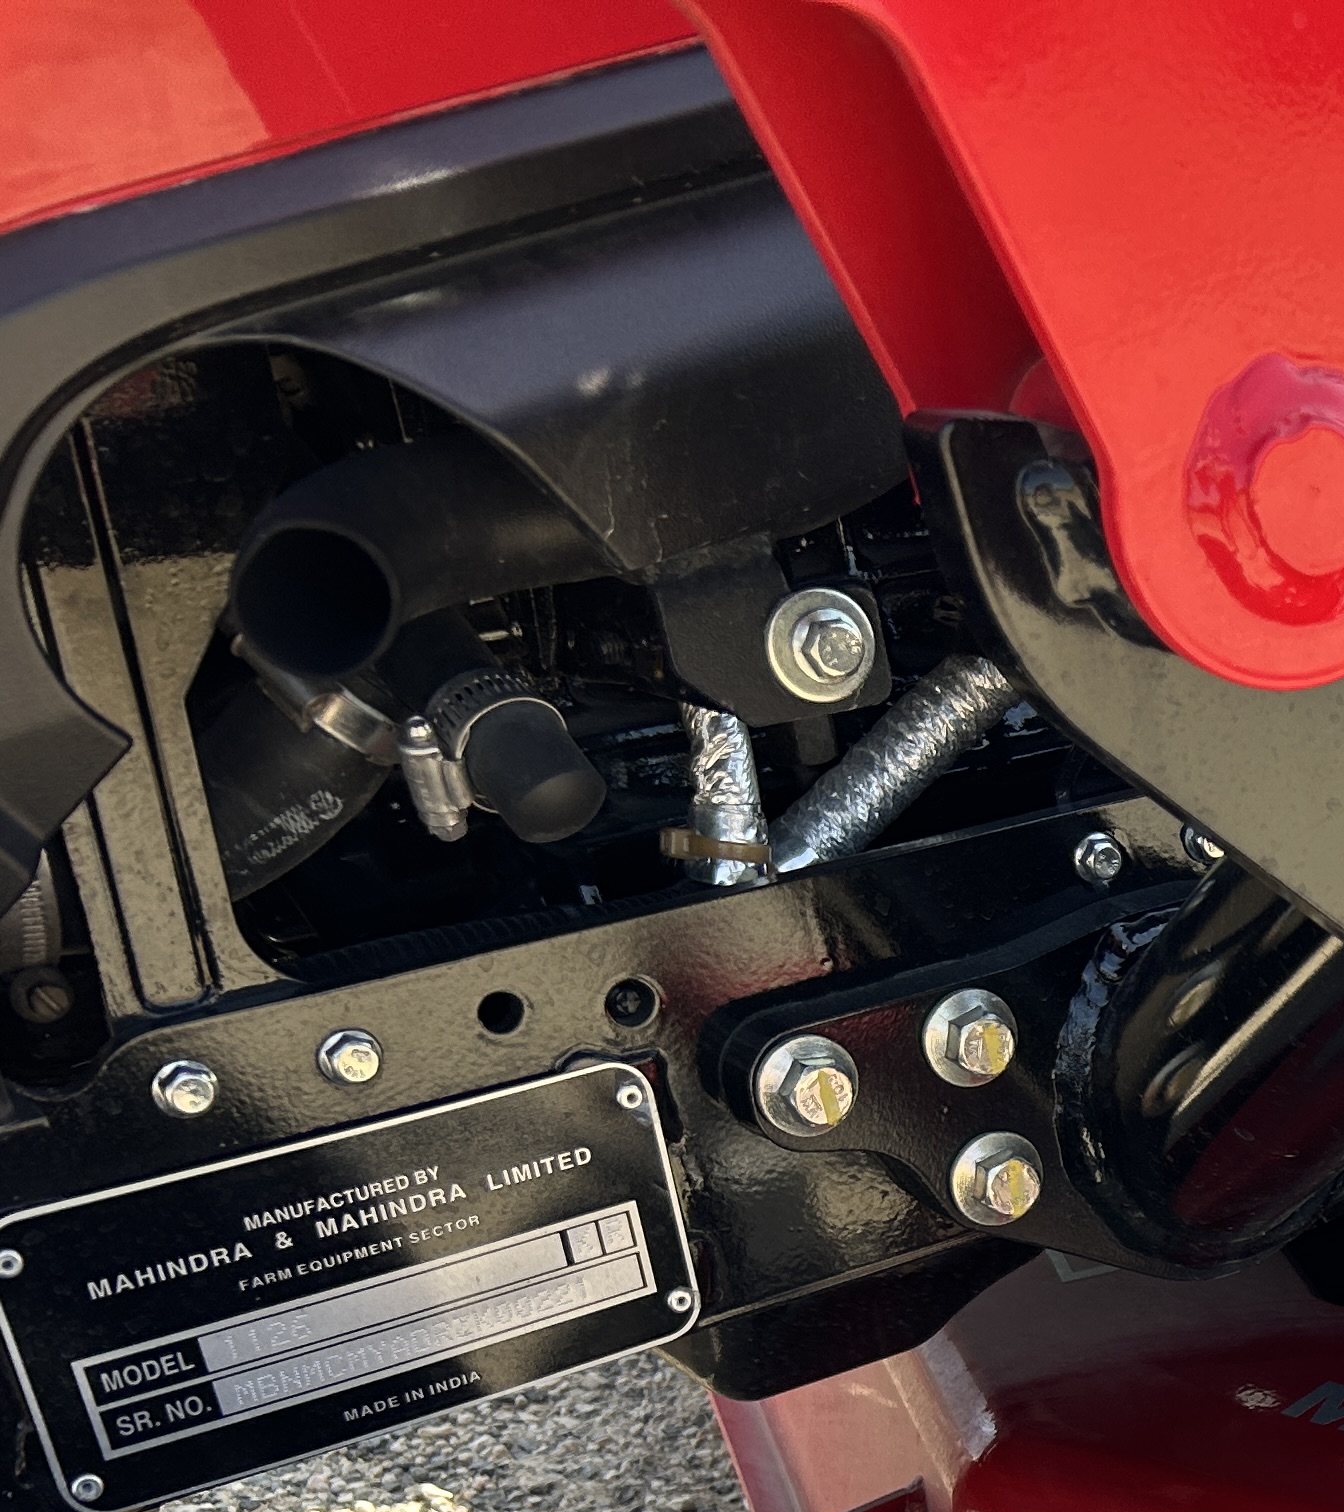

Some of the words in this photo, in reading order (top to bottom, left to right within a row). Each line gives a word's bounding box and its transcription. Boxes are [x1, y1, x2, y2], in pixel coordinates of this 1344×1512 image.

[86, 1239, 253, 1304] MAHINDRA
[272, 1228, 294, 1251] &
[314, 1179, 466, 1239] MAHINDRA
[485, 1144, 593, 1191] LIMITED
[243, 1173, 407, 1233] MANUFACTURED
[413, 1163, 442, 1185] BY
[238, 1267, 293, 1293] FARM
[297, 1235, 404, 1277] EQUIPMENT
[408, 1214, 480, 1245] SECTOR
[100, 1347, 196, 1394] MODEL
[224, 1312, 311, 1357] 1126
[115, 1407, 161, 1438] SR.
[164, 1391, 213, 1424] NO.
[343, 1394, 400, 1422] MADE
[404, 1387, 424, 1403] IN
[428, 1369, 480, 1394] INDIA
